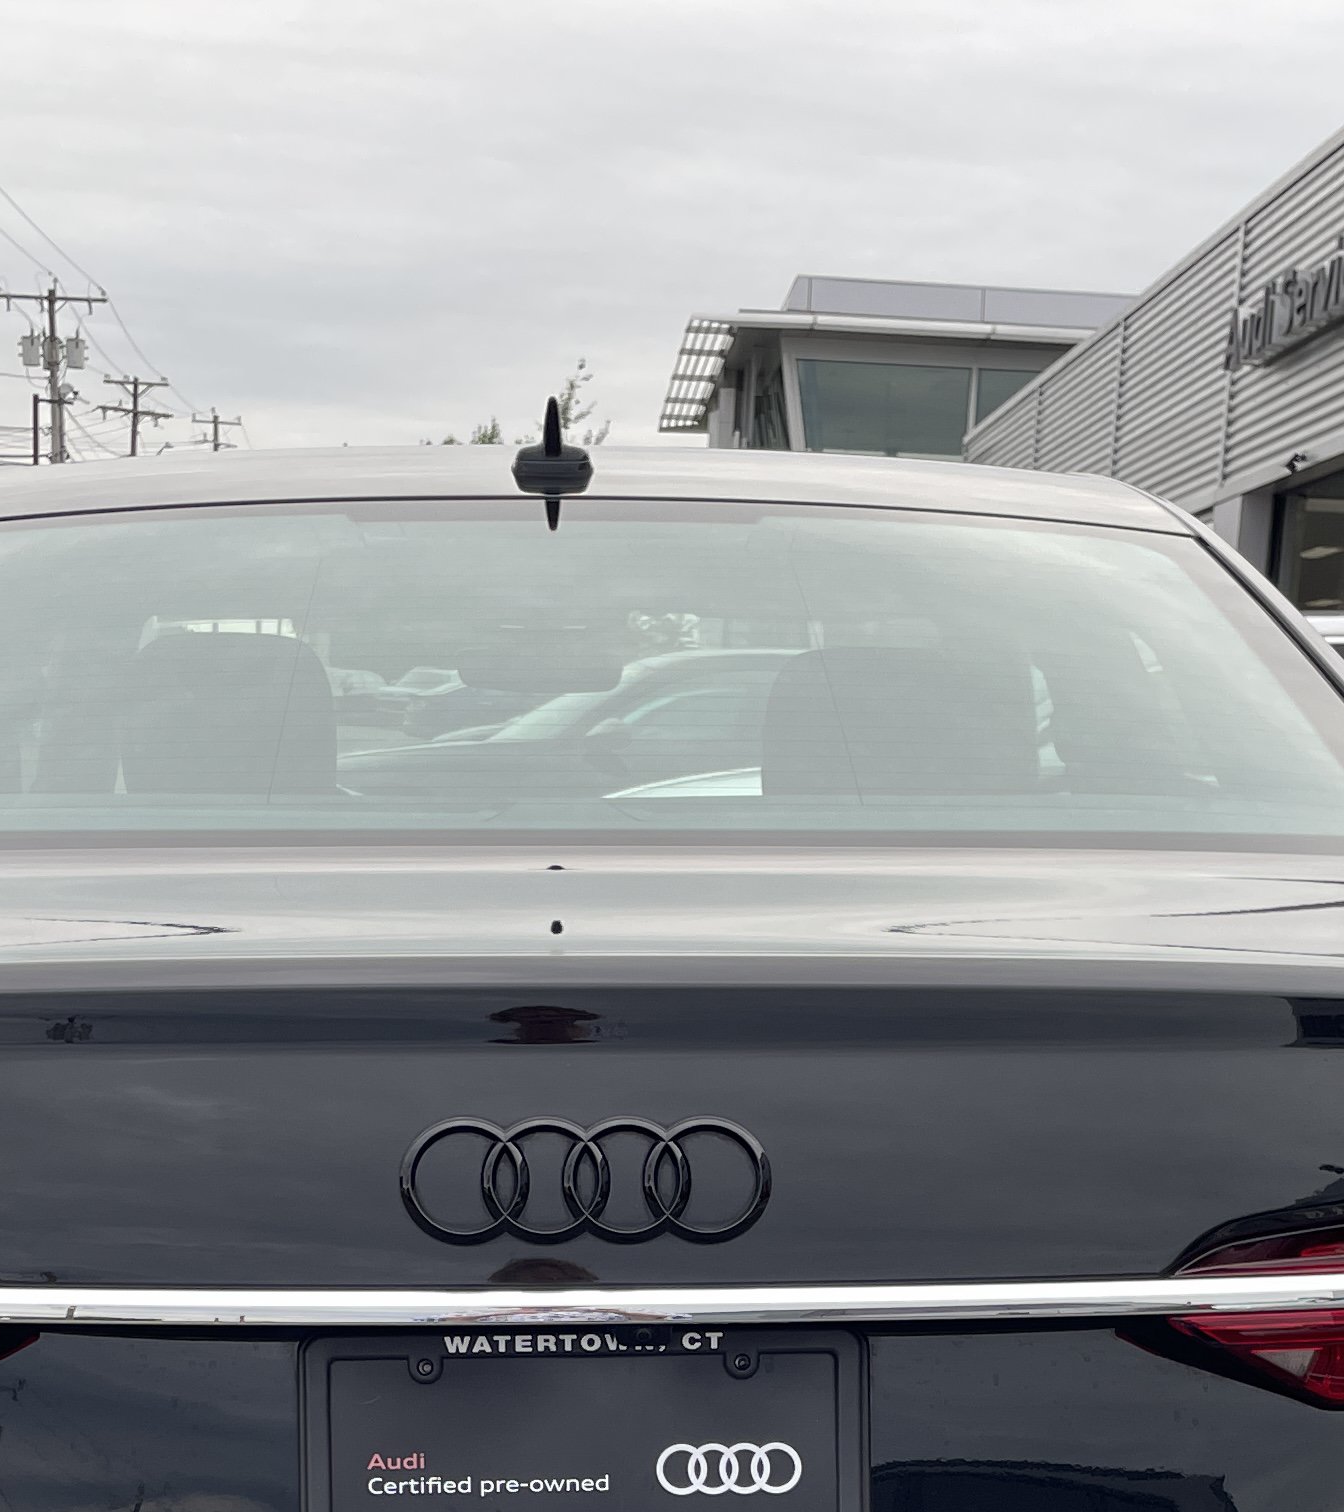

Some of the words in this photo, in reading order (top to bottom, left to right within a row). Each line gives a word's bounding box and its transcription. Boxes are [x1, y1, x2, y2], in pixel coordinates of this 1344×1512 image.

[442, 1332, 666, 1354] WATERTO,
[681, 1331, 723, 1351] CT
[367, 1452, 426, 1471] Audi
[367, 1475, 472, 1496] Certified
[479, 1474, 610, 1498] pre-owned
